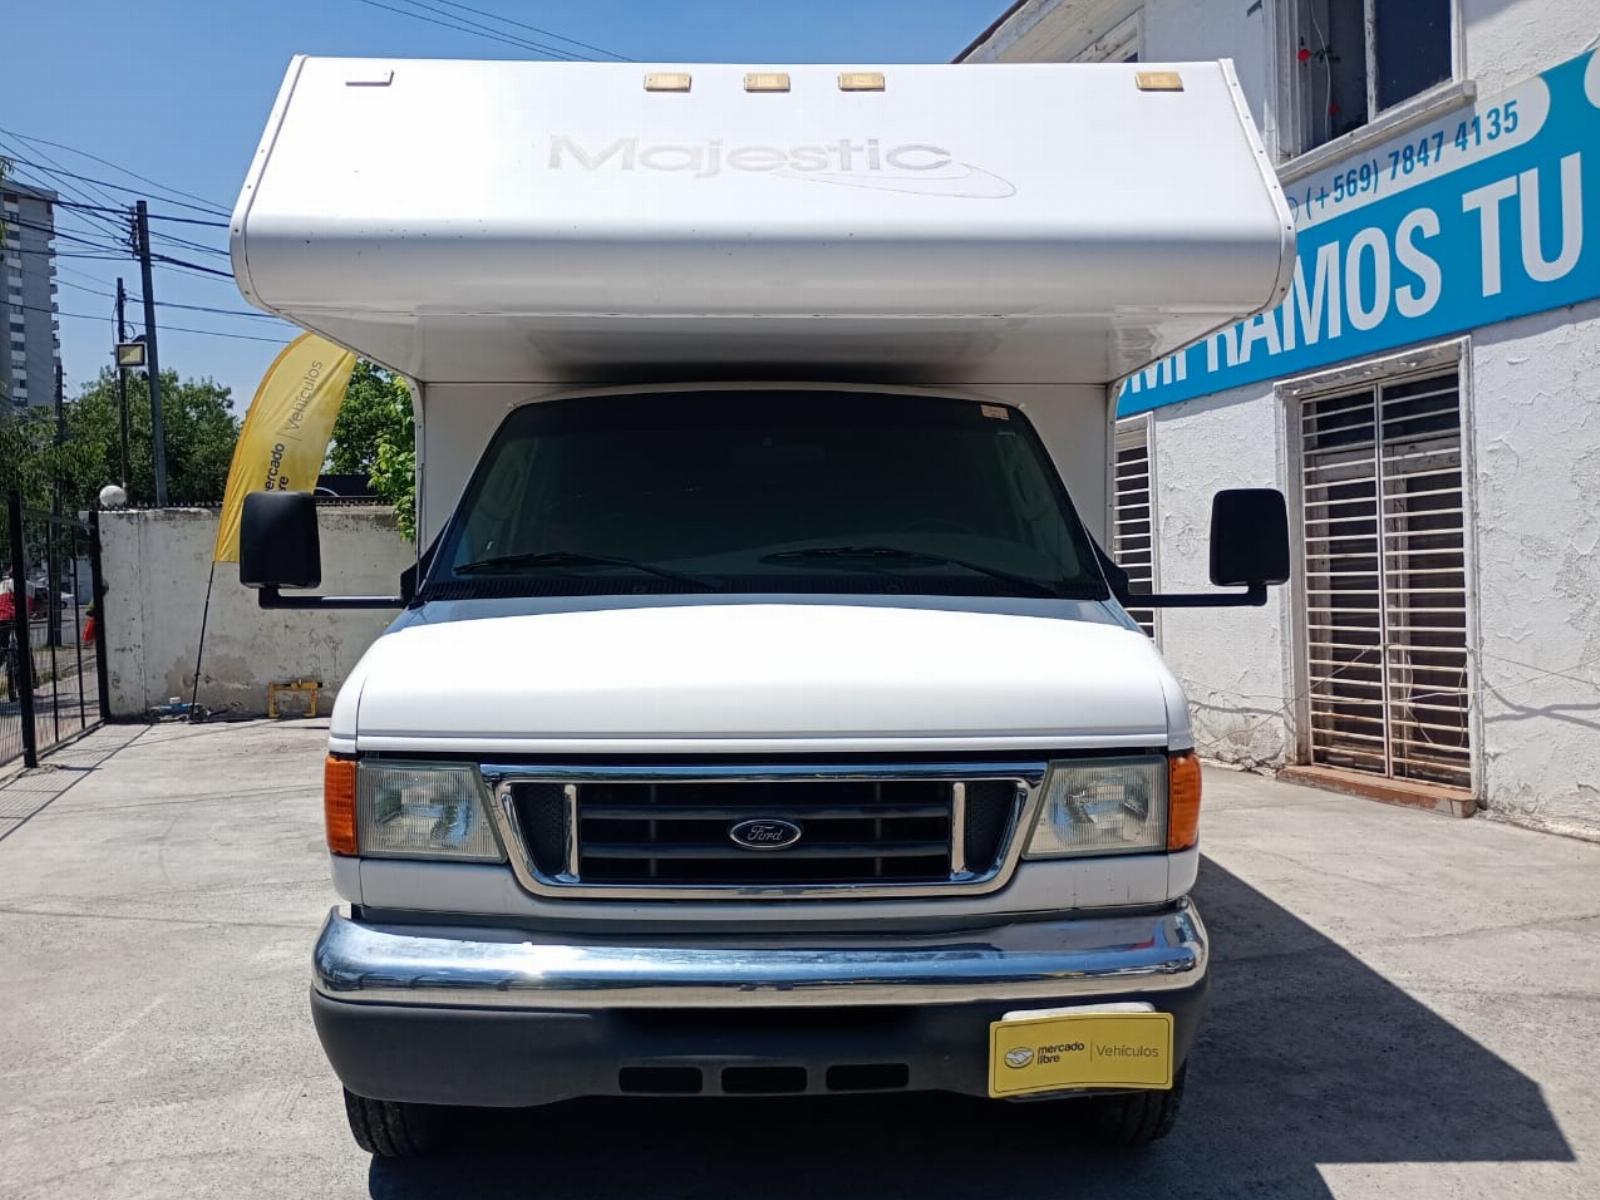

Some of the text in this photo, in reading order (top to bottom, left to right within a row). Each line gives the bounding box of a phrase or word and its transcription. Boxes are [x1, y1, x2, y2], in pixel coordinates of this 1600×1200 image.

[547, 135, 952, 178] Majestic
[1306, 100, 1518, 220] (+569) 7847 4135
[1119, 152, 1584, 398] RAMOS TU
[285, 359, 323, 431] Vehículos
[264, 443, 285, 491] ercado
[747, 825, 784, 841] Ford
[1037, 1040, 1086, 1056] mercado
[1037, 1053, 1061, 1066] libre
[1096, 1044, 1160, 1059] Vehículos
